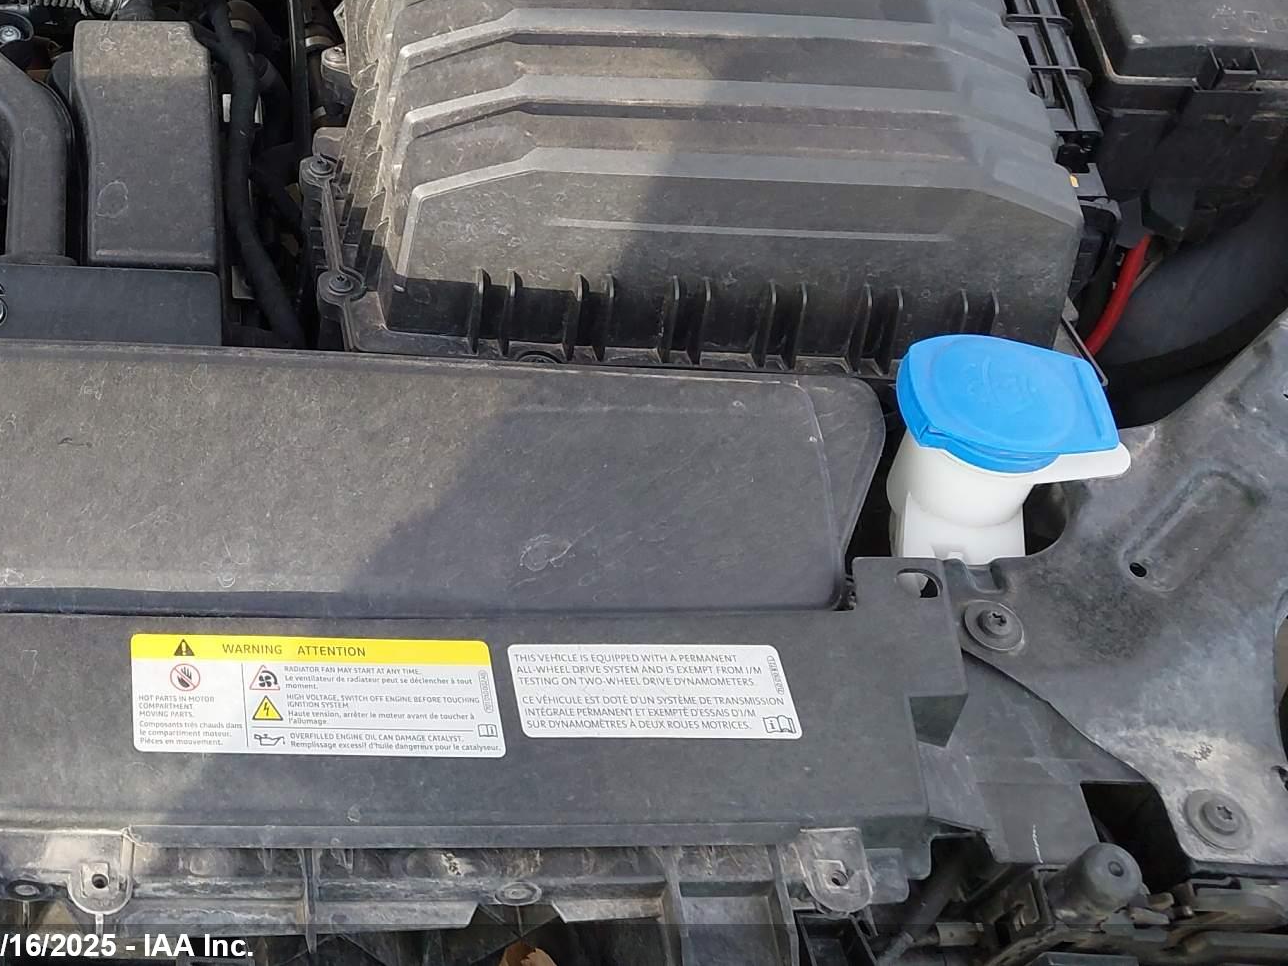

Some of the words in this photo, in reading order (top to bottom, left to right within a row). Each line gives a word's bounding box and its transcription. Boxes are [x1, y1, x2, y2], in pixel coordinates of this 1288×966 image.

[222, 643, 283, 655] WARNING
[297, 645, 366, 657] ATTENTION
[514, 654, 536, 662] THIS
[537, 654, 578, 662] VEHICLE
[580, 654, 588, 662] IS
[592, 654, 638, 663] EQUIPPED
[641, 654, 668, 662] WITH
[516, 666, 570, 674] ALL-WHEEL
[572, 666, 600, 674] DRIVE
[603, 666, 640, 674] SYSTEM
[642, 666, 663, 674] AND
[666, 666, 674, 674] IS
[676, 666, 712, 674] EXEMPT
[716, 666, 744, 674] FROM
[746, 666, 762, 674] I/M
[519, 677, 558, 685] TESTING
[562, 677, 577, 685] ON
[579, 677, 640, 685] TWO-WHEEL
[643, 678, 672, 686] DRIVE
[522, 696, 533, 704] CE
[537, 695, 582, 704] VÉHICULE
[585, 696, 600, 704] EST
[602, 695, 628, 704] DOTÉ
[630, 696, 655, 704] D'UN
[658, 695, 697, 704] SYSTÈME
[699, 696, 712, 704] DE
[714, 697, 784, 706] TRANSMISSION
[288, 710, 310, 718] Haute
[525, 707, 574, 716] INTÉGRALE
[576, 708, 632, 716] PERMANENT
[634, 708, 645, 716] ET
[648, 706, 689, 716] EXEMPTÉ
[692, 708, 729, 717] D'ESSAIS
[527, 720, 546, 728] SUR
[548, 719, 627, 729] DYNAMOMÈTRES
[639, 720, 665, 729] DEUX
[667, 721, 699, 729] ROUES
[702, 721, 752, 729] MOTRICES.
[291, 741, 337, 749] Remplissage
[338, 741, 367, 749] excessif
[395, 743, 432, 752] dangereux
[462, 744, 501, 752] catalyseur.
